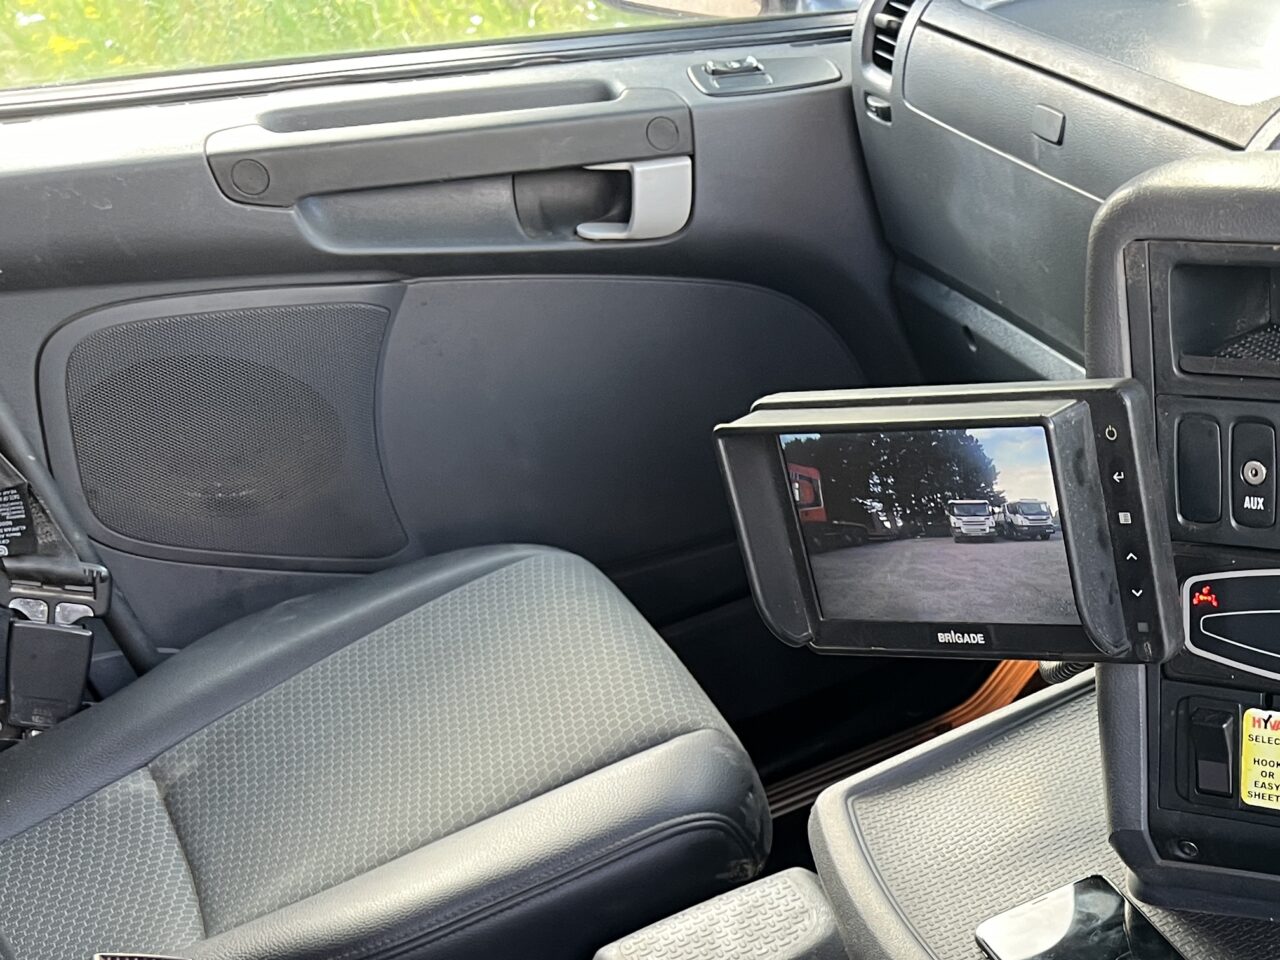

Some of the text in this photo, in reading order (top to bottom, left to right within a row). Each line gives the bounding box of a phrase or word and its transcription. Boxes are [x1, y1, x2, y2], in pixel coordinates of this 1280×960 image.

[1243, 496, 1264, 511] AUX
[937, 630, 986, 644] BRIGADE
[1260, 770, 1275, 780] OR
[1254, 781, 1280, 791] EASY
